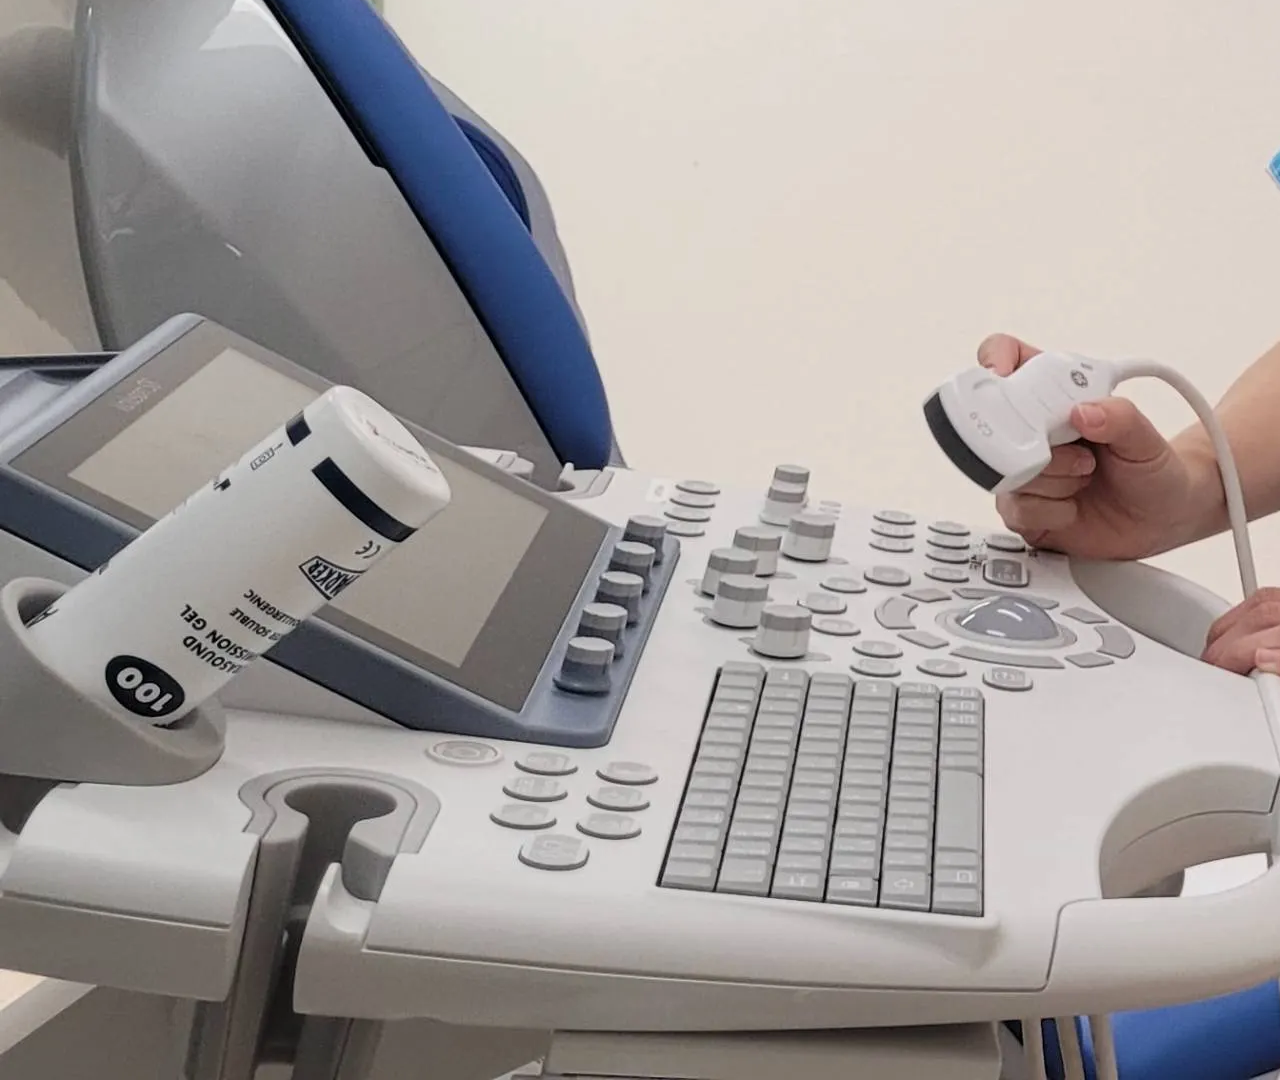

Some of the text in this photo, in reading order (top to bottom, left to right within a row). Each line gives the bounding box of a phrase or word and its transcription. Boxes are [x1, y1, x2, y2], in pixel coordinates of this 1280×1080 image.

[180, 604, 207, 631] GEL
[229, 607, 272, 637] SOLUBLE
[116, 666, 173, 712] 100
